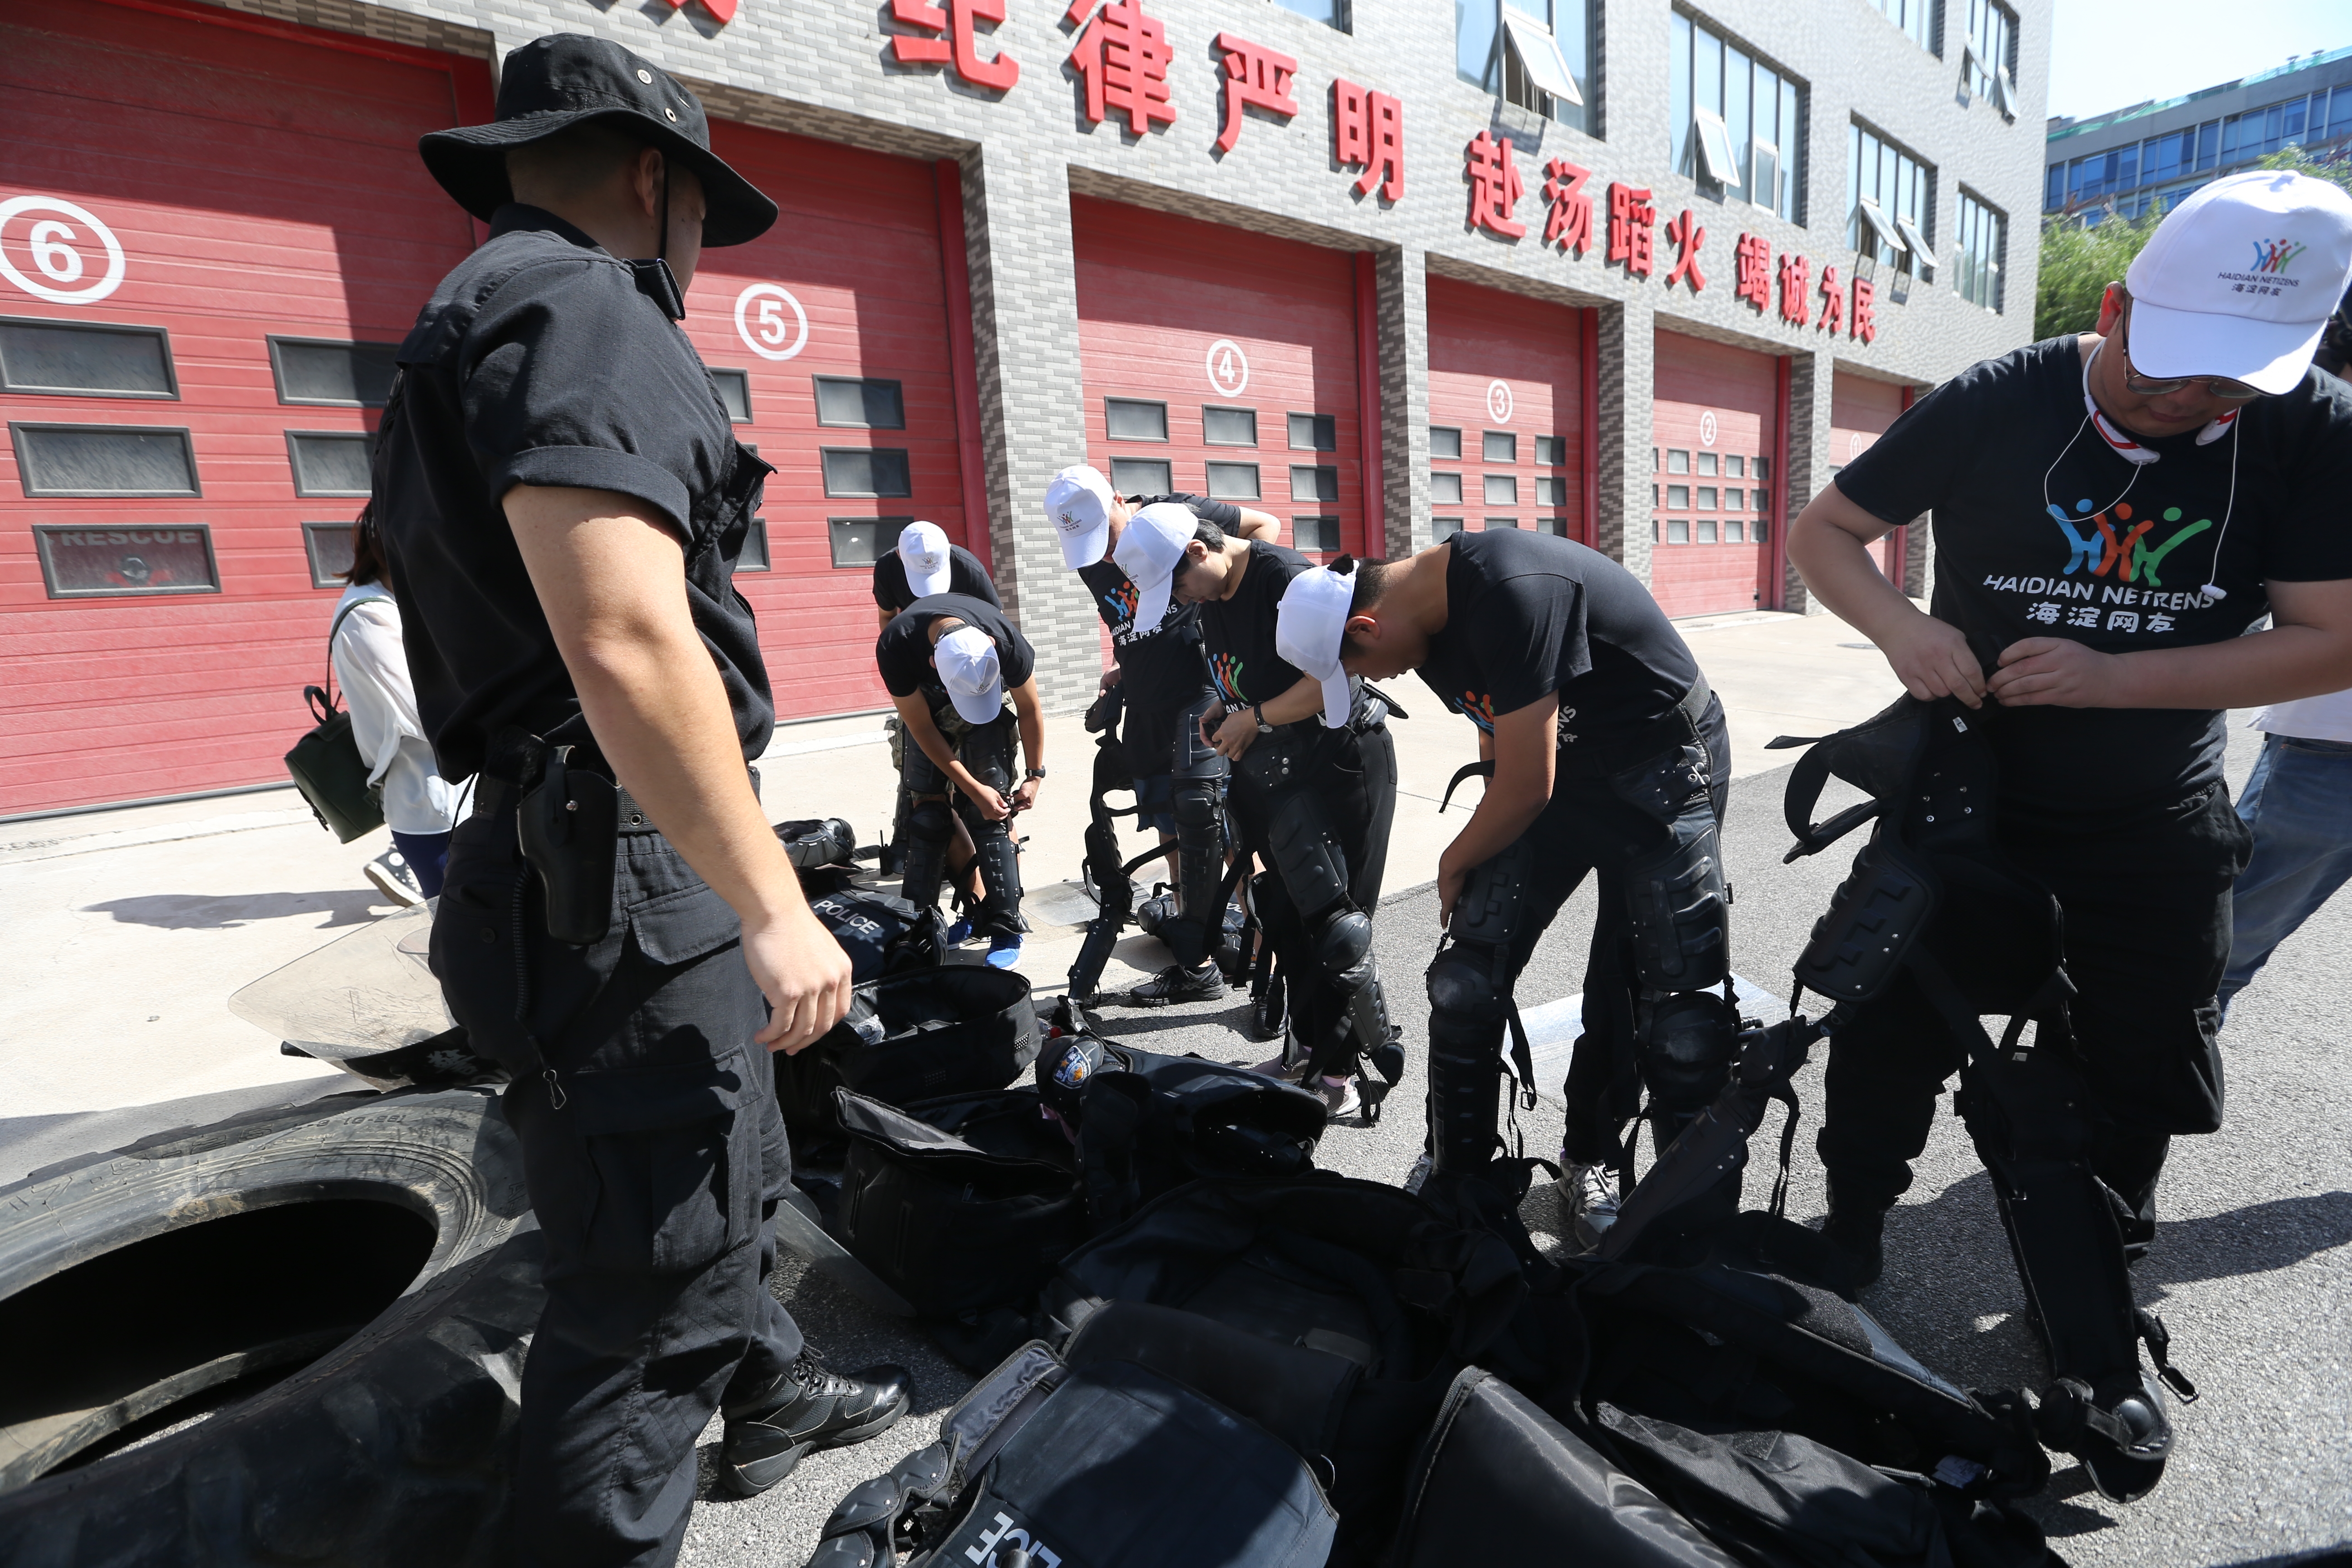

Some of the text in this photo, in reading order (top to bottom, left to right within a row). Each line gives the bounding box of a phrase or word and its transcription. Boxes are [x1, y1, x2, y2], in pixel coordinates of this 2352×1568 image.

[1468, 131, 1706, 291] 赴汤蹈火
[1737, 232, 1876, 342] 竭诚为民
[30, 220, 83, 283] 6
[2217, 271, 2299, 287] HAIDIAN NETIZENS
[2231, 283, 2282, 296] 海淀网友
[759, 299, 786, 345] 5
[1218, 350, 1235, 383] 4
[1495, 389, 1506, 415] 3
[1705, 418, 1712, 439] 2
[59, 531, 199, 547] RESCUE
[1983, 575, 2094, 601] HAIDIAN
[1111, 620, 1131, 636] AIDIAN
[2026, 601, 2176, 633] 海淀网友
[813, 900, 880, 935] POLICE
